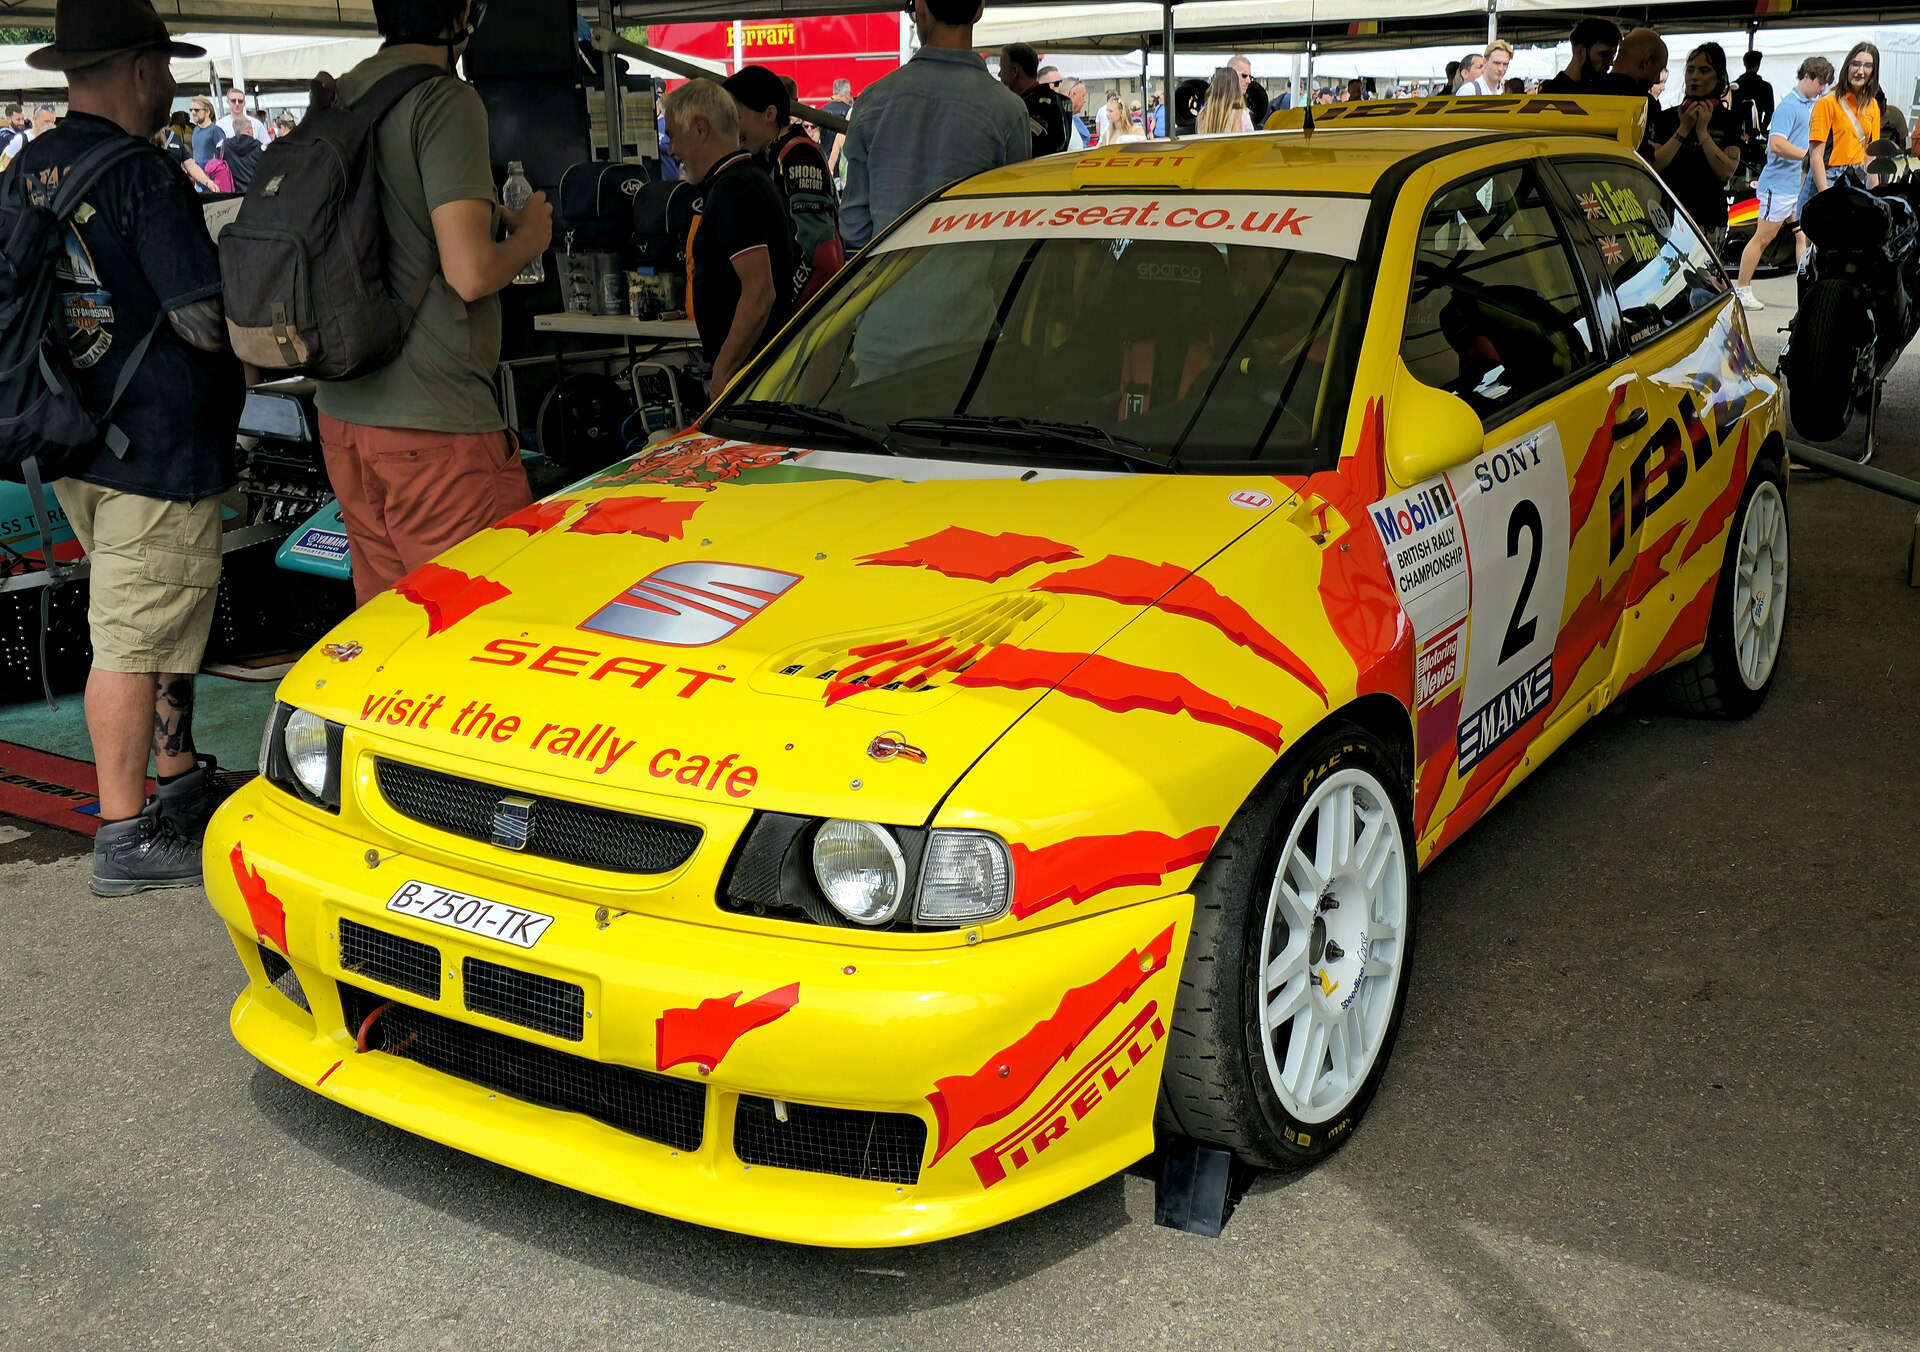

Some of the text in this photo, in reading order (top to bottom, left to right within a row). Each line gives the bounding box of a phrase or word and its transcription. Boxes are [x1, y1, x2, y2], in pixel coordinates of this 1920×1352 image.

[1314, 99, 1589, 121] IBIZA
[1076, 156, 1195, 168] SEAT
[798, 178, 824, 191] FACTORY
[927, 201, 1312, 236] www.seat.co.uk
[1137, 261, 1201, 279] sparco
[1474, 435, 1541, 494] SONY
[1374, 485, 1451, 545] Mobil 1
[306, 542, 339, 551] RACING
[316, 534, 349, 548] YAMAHA
[1396, 526, 1456, 570] BRITISH RALLY
[1399, 546, 1463, 593] CHAMPIONSHIP
[1497, 499, 1543, 667] 2
[470, 639, 736, 699] SEAT
[1420, 640, 1457, 674] Motoring
[1418, 660, 1455, 704] News
[1478, 671, 1535, 755] MANX
[360, 689, 759, 798] visit the rally cafe
[392, 883, 547, 943] B-7501-TK
[1356, 931, 1368, 965] Corse
[1340, 967, 1365, 1010] Speedline
[969, 999, 1166, 1190] PIRELLI
